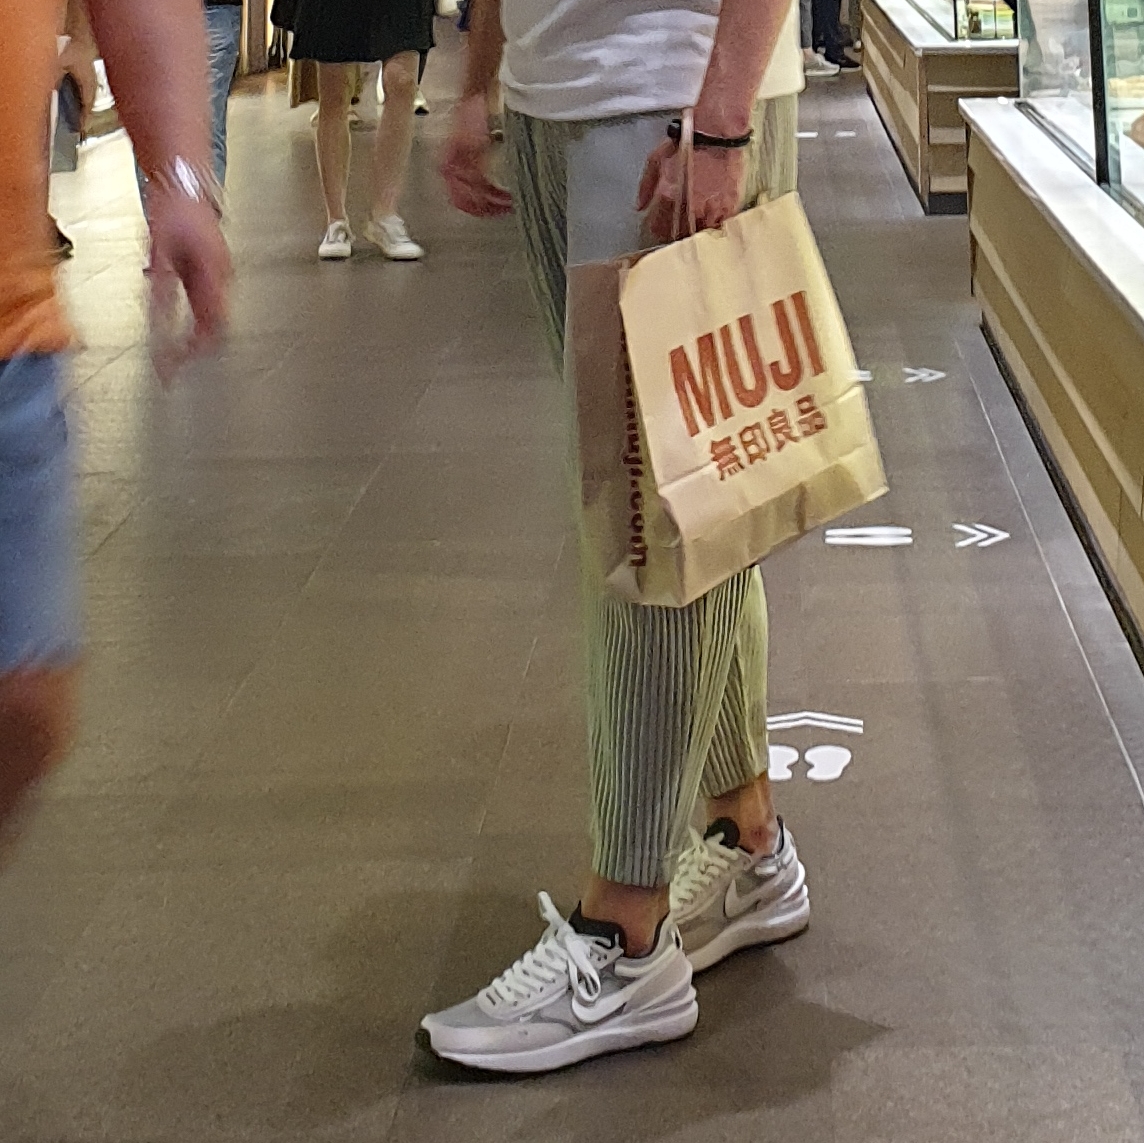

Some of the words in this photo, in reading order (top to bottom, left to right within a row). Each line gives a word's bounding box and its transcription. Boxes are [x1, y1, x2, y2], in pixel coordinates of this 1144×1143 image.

[668, 289, 826, 438] MUJI
[708, 394, 828, 481] 無印良品
